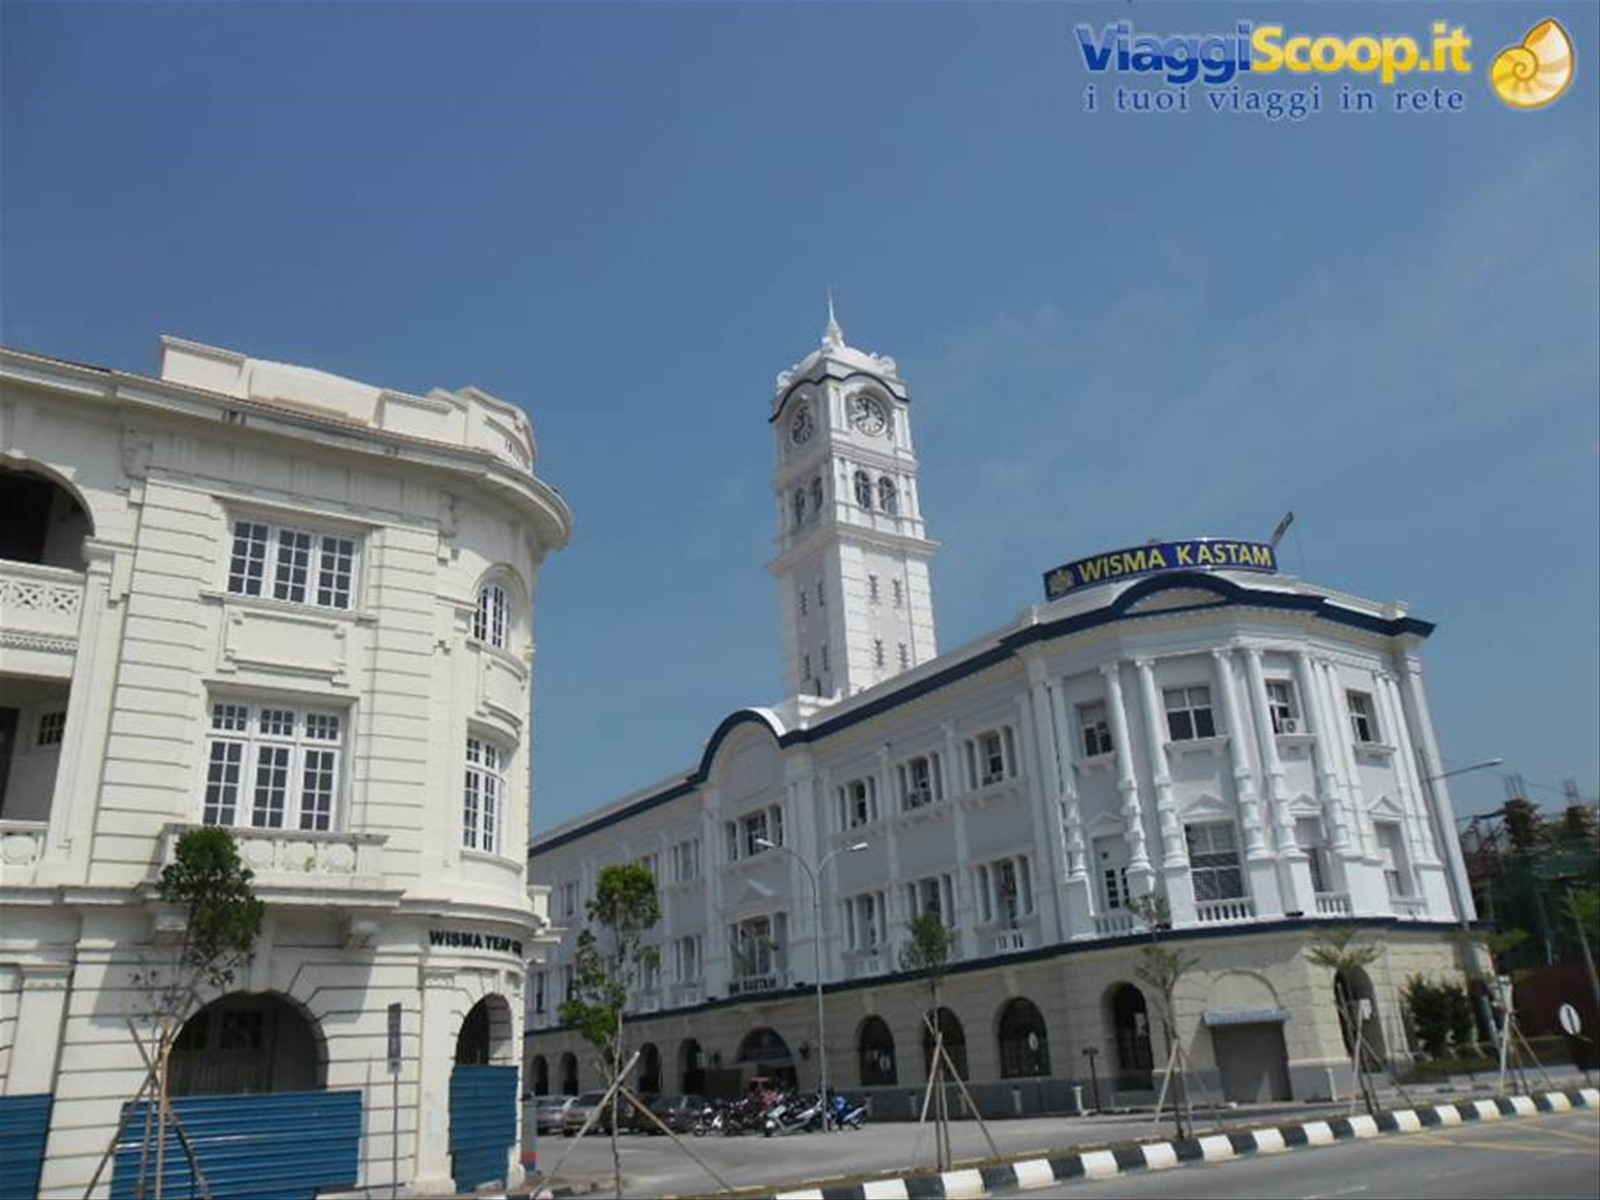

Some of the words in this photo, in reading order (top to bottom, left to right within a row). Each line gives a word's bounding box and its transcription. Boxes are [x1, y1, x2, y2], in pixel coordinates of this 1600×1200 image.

[1078, 548, 1167, 583] WISMA
[1176, 543, 1272, 567] KASTAM
[428, 930, 483, 949] WISMA
